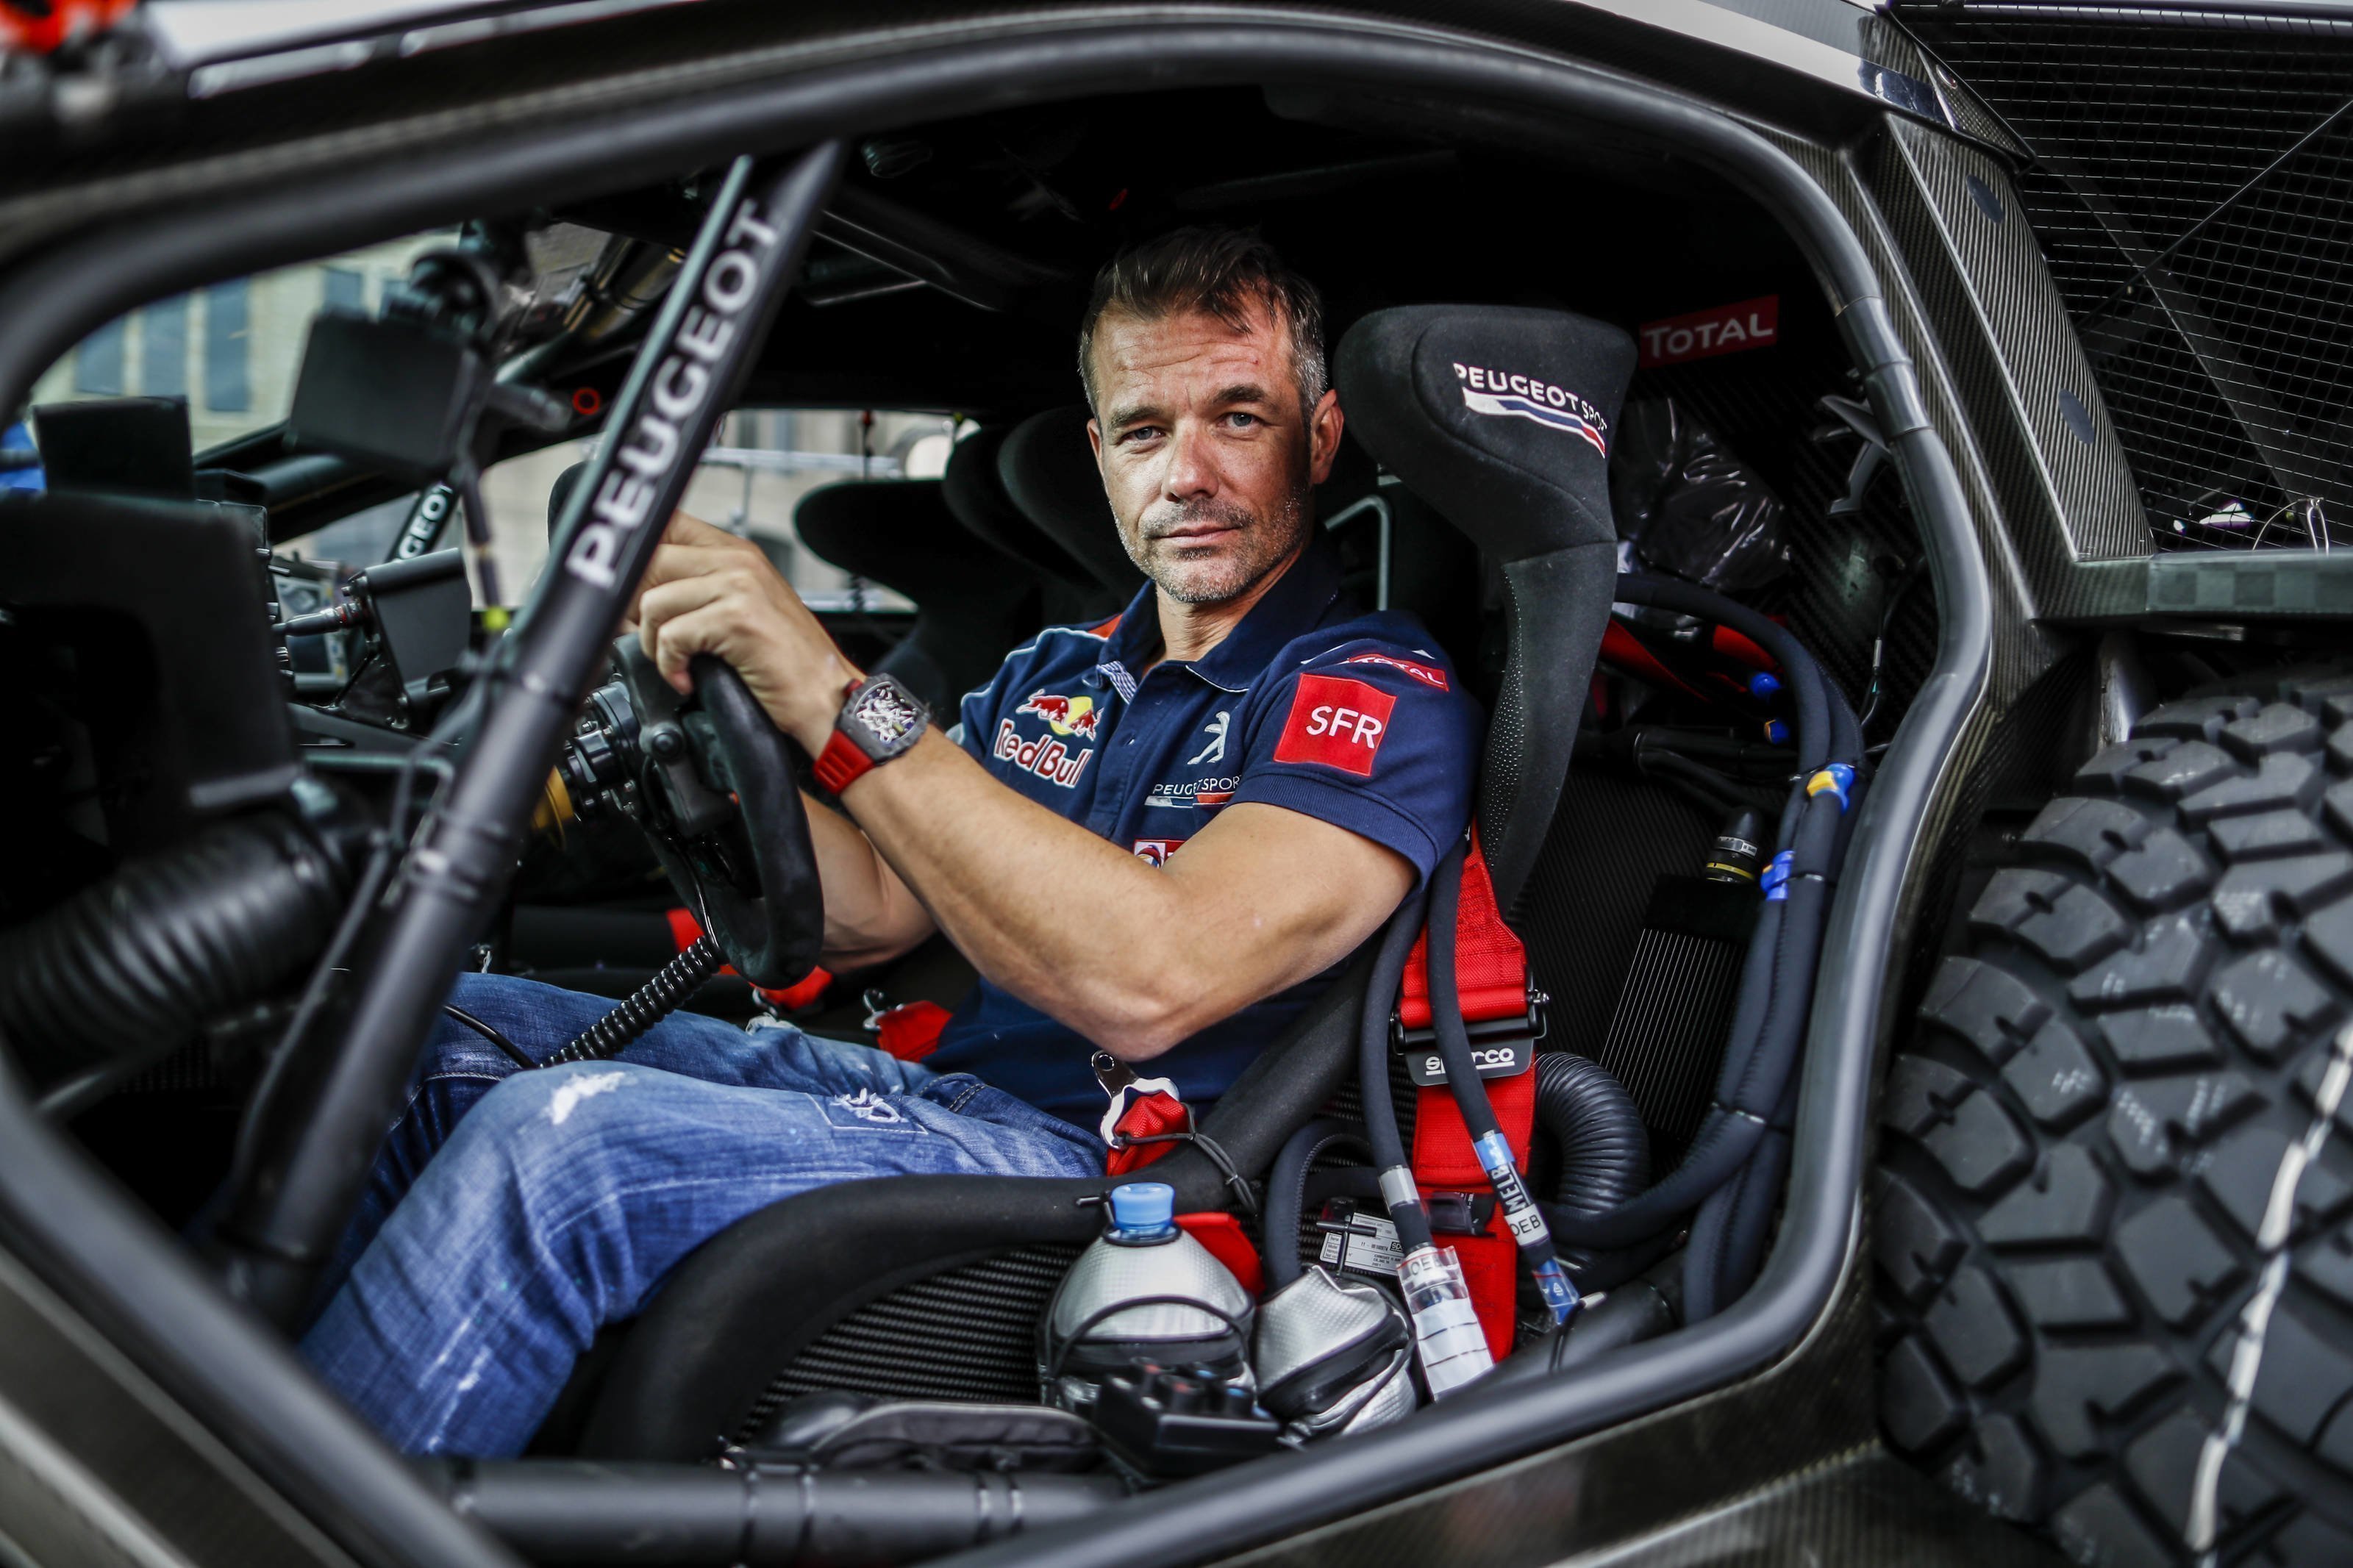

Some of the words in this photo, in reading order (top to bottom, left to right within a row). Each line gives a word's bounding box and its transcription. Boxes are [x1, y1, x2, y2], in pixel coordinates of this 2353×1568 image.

[1643, 312, 1774, 359] TOTAL
[564, 198, 779, 588] PEUGEOT
[1453, 362, 1579, 412] PEUGEOT
[399, 484, 453, 559] GEOT
[1305, 706, 1382, 749] SFR
[993, 717, 1053, 772] Red
[1033, 740, 1094, 789] Bull
[1202, 775, 1242, 791] SPOR
[1425, 1048, 1515, 1074] srco
[1509, 1214, 1542, 1237] OEB
